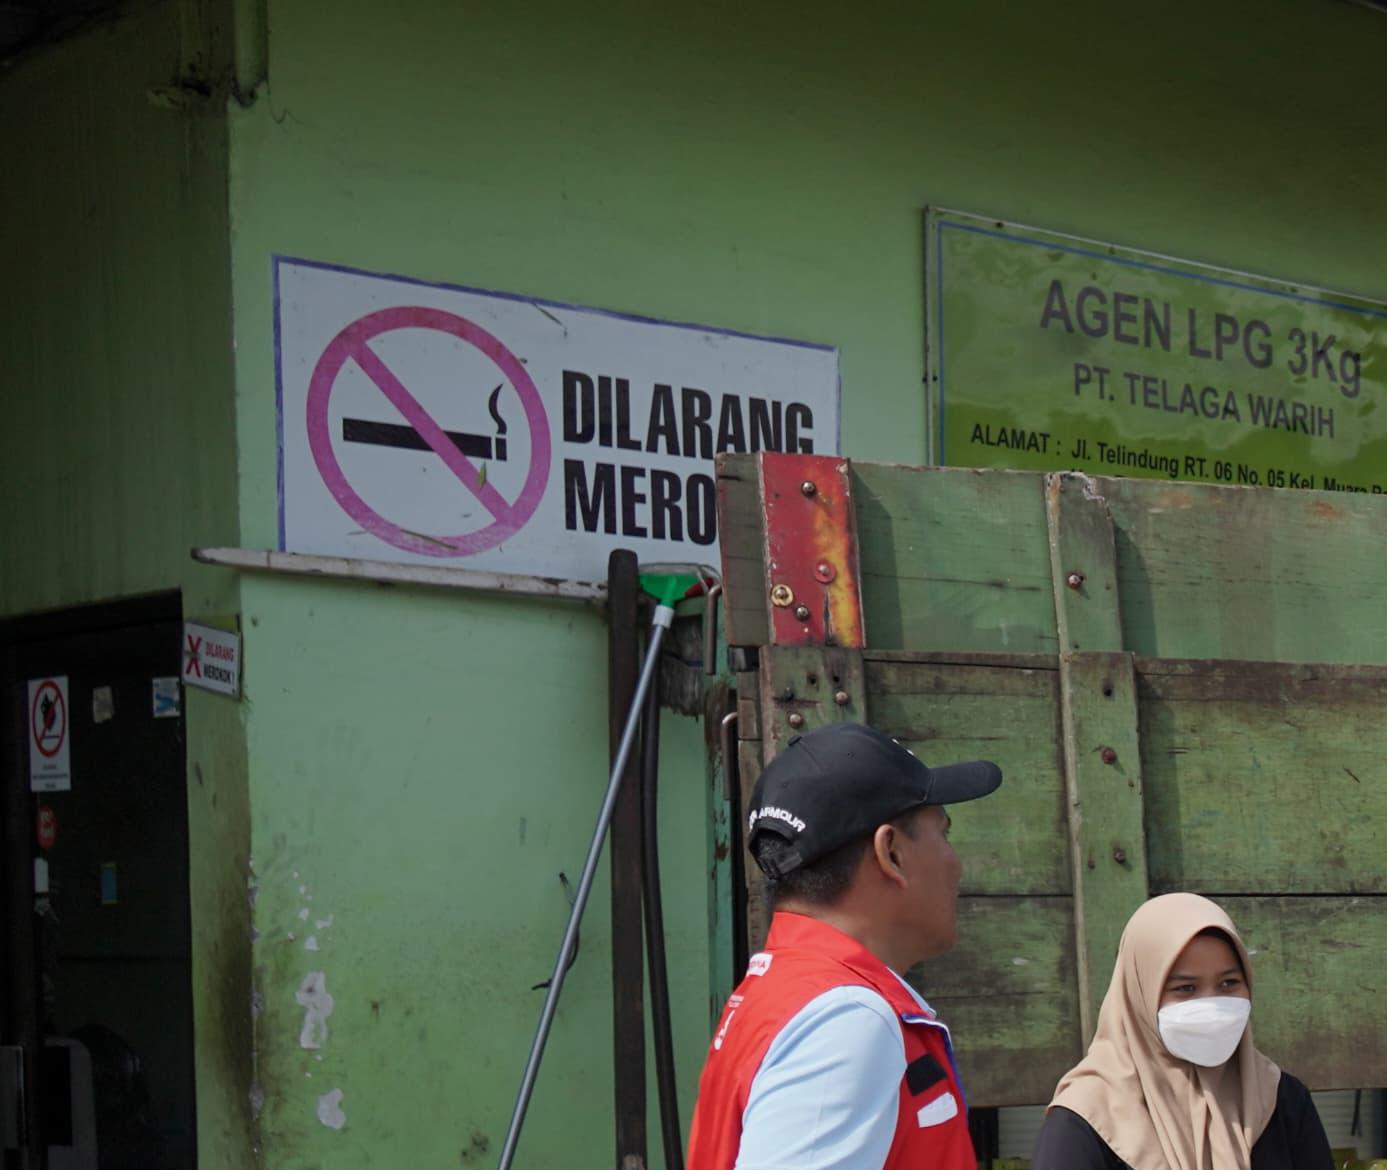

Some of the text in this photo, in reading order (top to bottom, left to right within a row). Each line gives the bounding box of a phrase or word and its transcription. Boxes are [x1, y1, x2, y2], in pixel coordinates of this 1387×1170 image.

[1040, 279, 1361, 398] AGEN LPG 3Kg
[562, 369, 814, 461] DILARANG
[1074, 362, 1334, 439] PT. TELAGA WARIH
[971, 423, 1050, 454] ALAMAT
[1071, 439, 1091, 461] Jl.
[1097, 442, 1179, 479] Telindung
[1184, 456, 1209, 478] RT.
[1214, 462, 1232, 481] 06
[1238, 464, 1262, 487] No.
[1268, 469, 1285, 488] 05
[564, 458, 717, 546] MERO
[759, 806, 806, 832] ARMOUR
